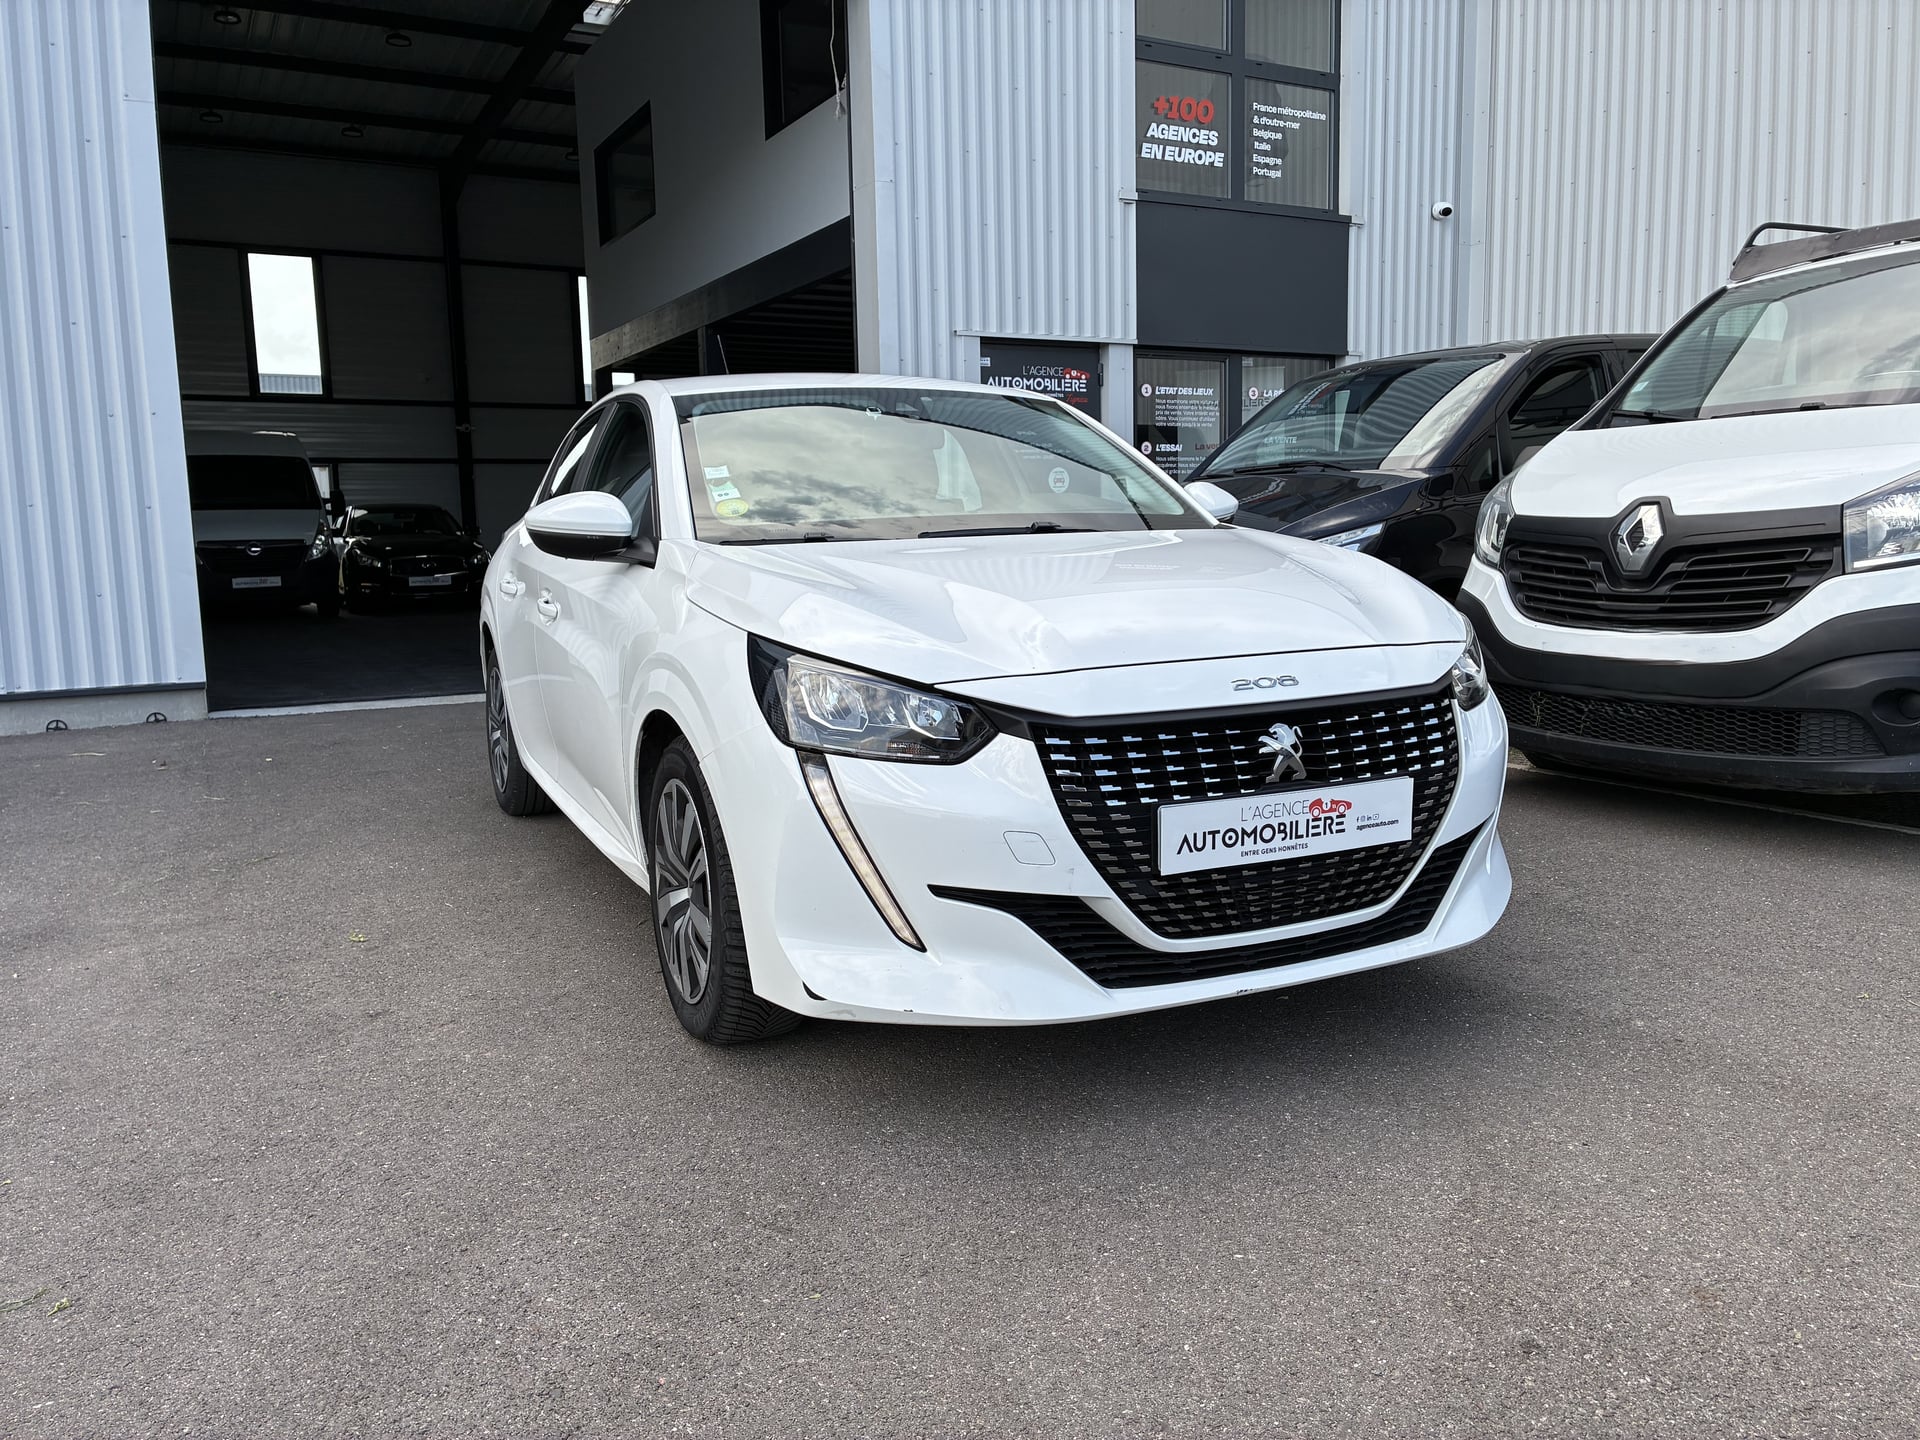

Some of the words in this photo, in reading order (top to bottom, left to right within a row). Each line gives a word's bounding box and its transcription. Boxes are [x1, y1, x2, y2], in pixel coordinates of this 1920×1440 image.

[1153, 96, 1214, 124] +100
[1253, 102, 1277, 114] France
[1277, 106, 1326, 121] métropolitaine
[1253, 116, 1260, 124] &
[1260, 116, 1300, 130] d'outre-mer
[1146, 122, 1218, 146] AGENCES
[1253, 128, 1282, 140] Belgique
[1254, 141, 1271, 151] Italie
[1141, 142, 1163, 160] EN
[1164, 146, 1224, 167] EUROPE
[1253, 154, 1282, 166] Espagne
[1253, 166, 1282, 178] Portugal
[1022, 365, 1064, 377] L'AGENCE
[1155, 386, 1178, 395] L'ETAT
[1178, 386, 1193, 395] DES
[1193, 387, 1214, 396] LIEUX
[1263, 389, 1273, 397] LA
[1156, 443, 1182, 452] L'ESSAI
[1231, 675, 1299, 691] 208
[1241, 799, 1309, 822] L'AGENCE
[1356, 819, 1399, 831] agenceauto.com
[1240, 849, 1260, 857] ENTRE
[1278, 842, 1309, 852] HONNÊTES
